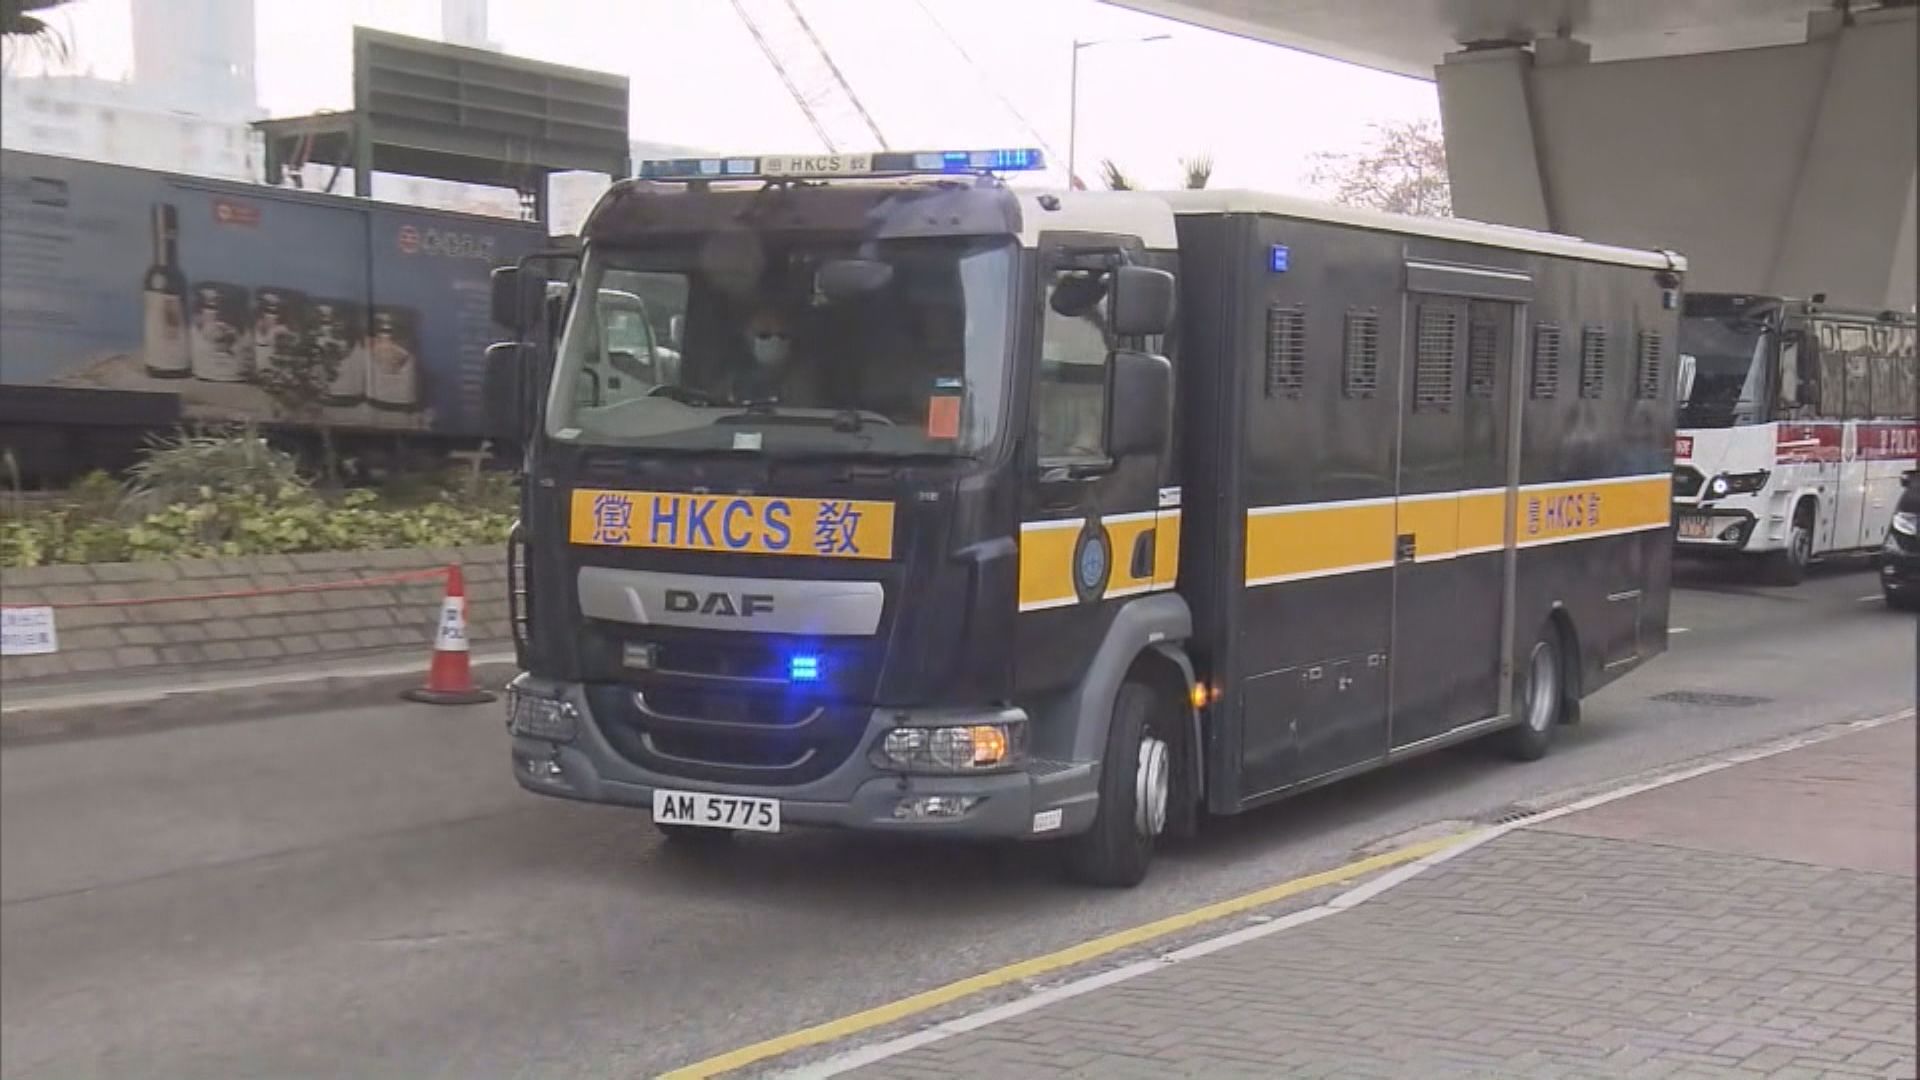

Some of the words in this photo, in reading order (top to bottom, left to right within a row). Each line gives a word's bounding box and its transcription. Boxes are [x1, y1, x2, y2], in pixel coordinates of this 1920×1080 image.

[791, 156, 840, 171] HKCS
[650, 496, 792, 550] HKCS
[664, 589, 774, 616] DAF
[662, 795, 695, 820] AM
[707, 799, 773, 827] 5775
